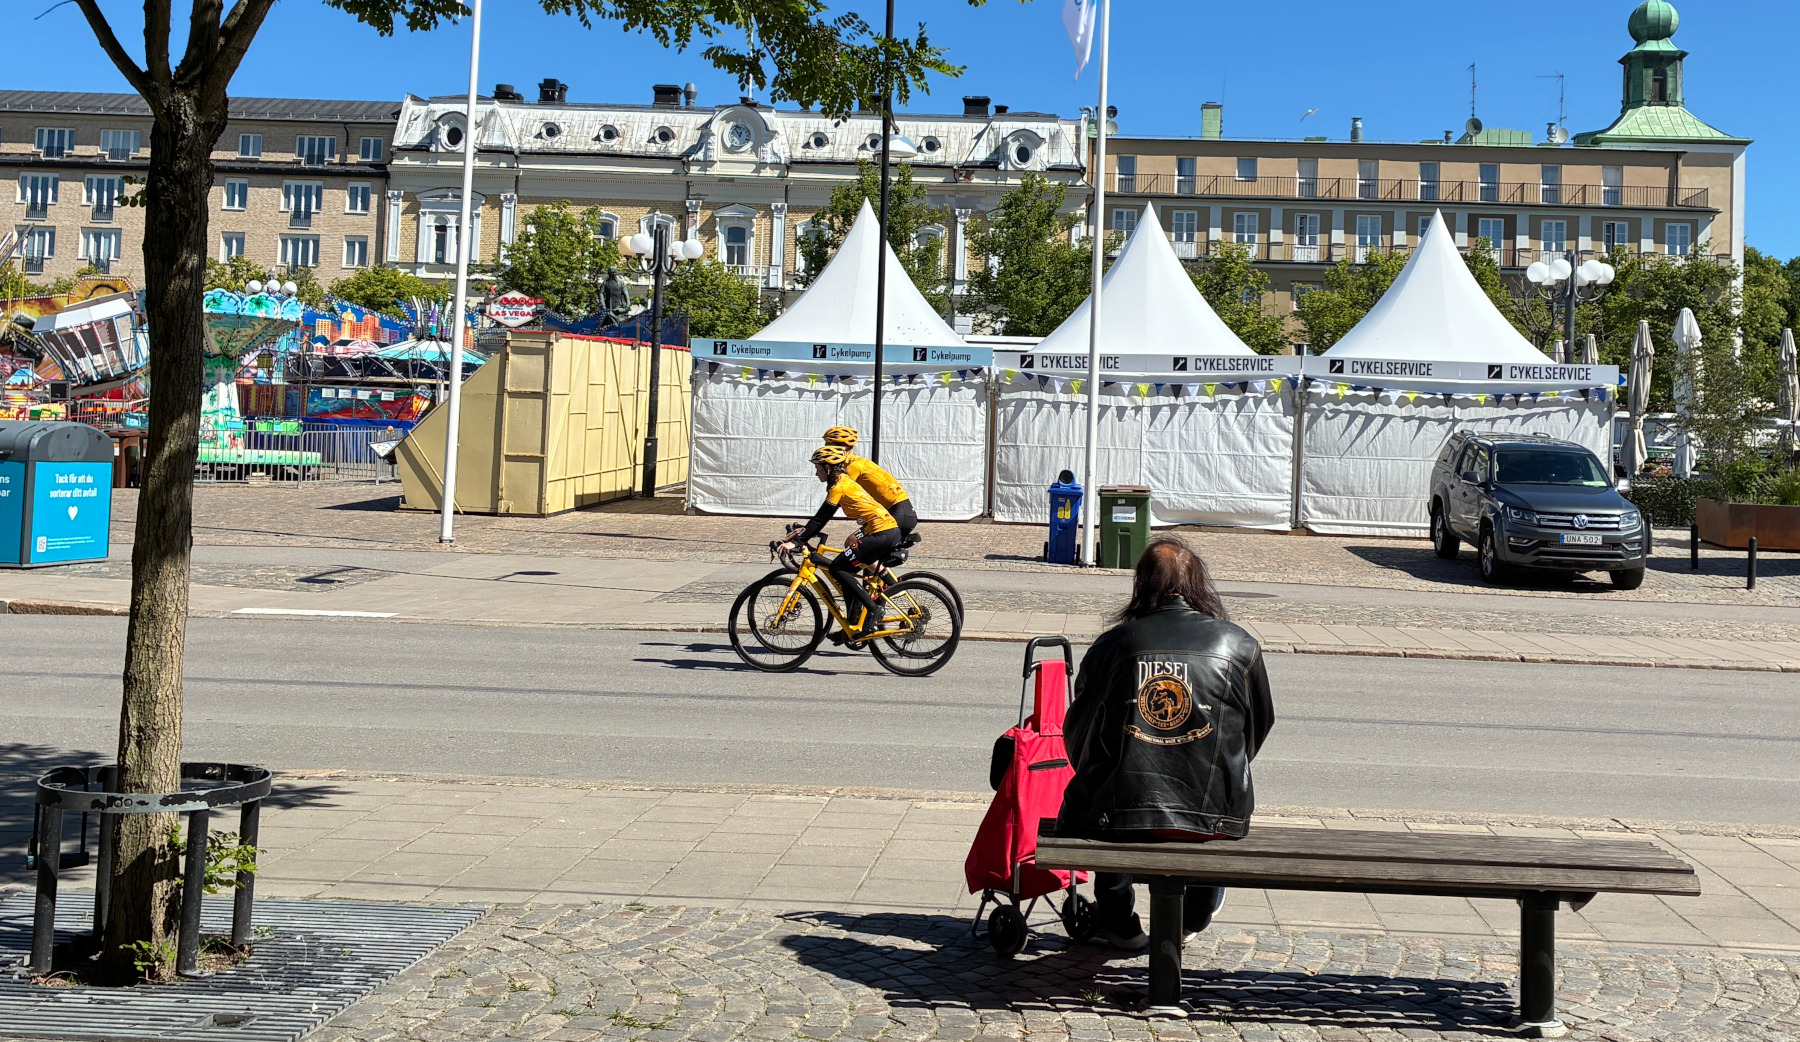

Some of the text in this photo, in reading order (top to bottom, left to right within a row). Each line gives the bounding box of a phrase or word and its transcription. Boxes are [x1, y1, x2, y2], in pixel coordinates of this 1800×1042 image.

[731, 344, 771, 355] Cykelpump
[831, 347, 872, 359] Cykelpump
[931, 350, 972, 362] Cykelpump
[1041, 355, 1120, 369] CYKELSEICE
[1194, 358, 1275, 371] CYKELSERVICE
[1351, 360, 1433, 376] CYKELSERVICE
[1510, 365, 1592, 381] CYKELSERVICE
[55, 473, 94, 484] Tack för att du
[50, 487, 97, 498] sorterar ditt avfall
[1566, 535, 1582, 543] UNA
[1138, 661, 1193, 694] DIESEL
